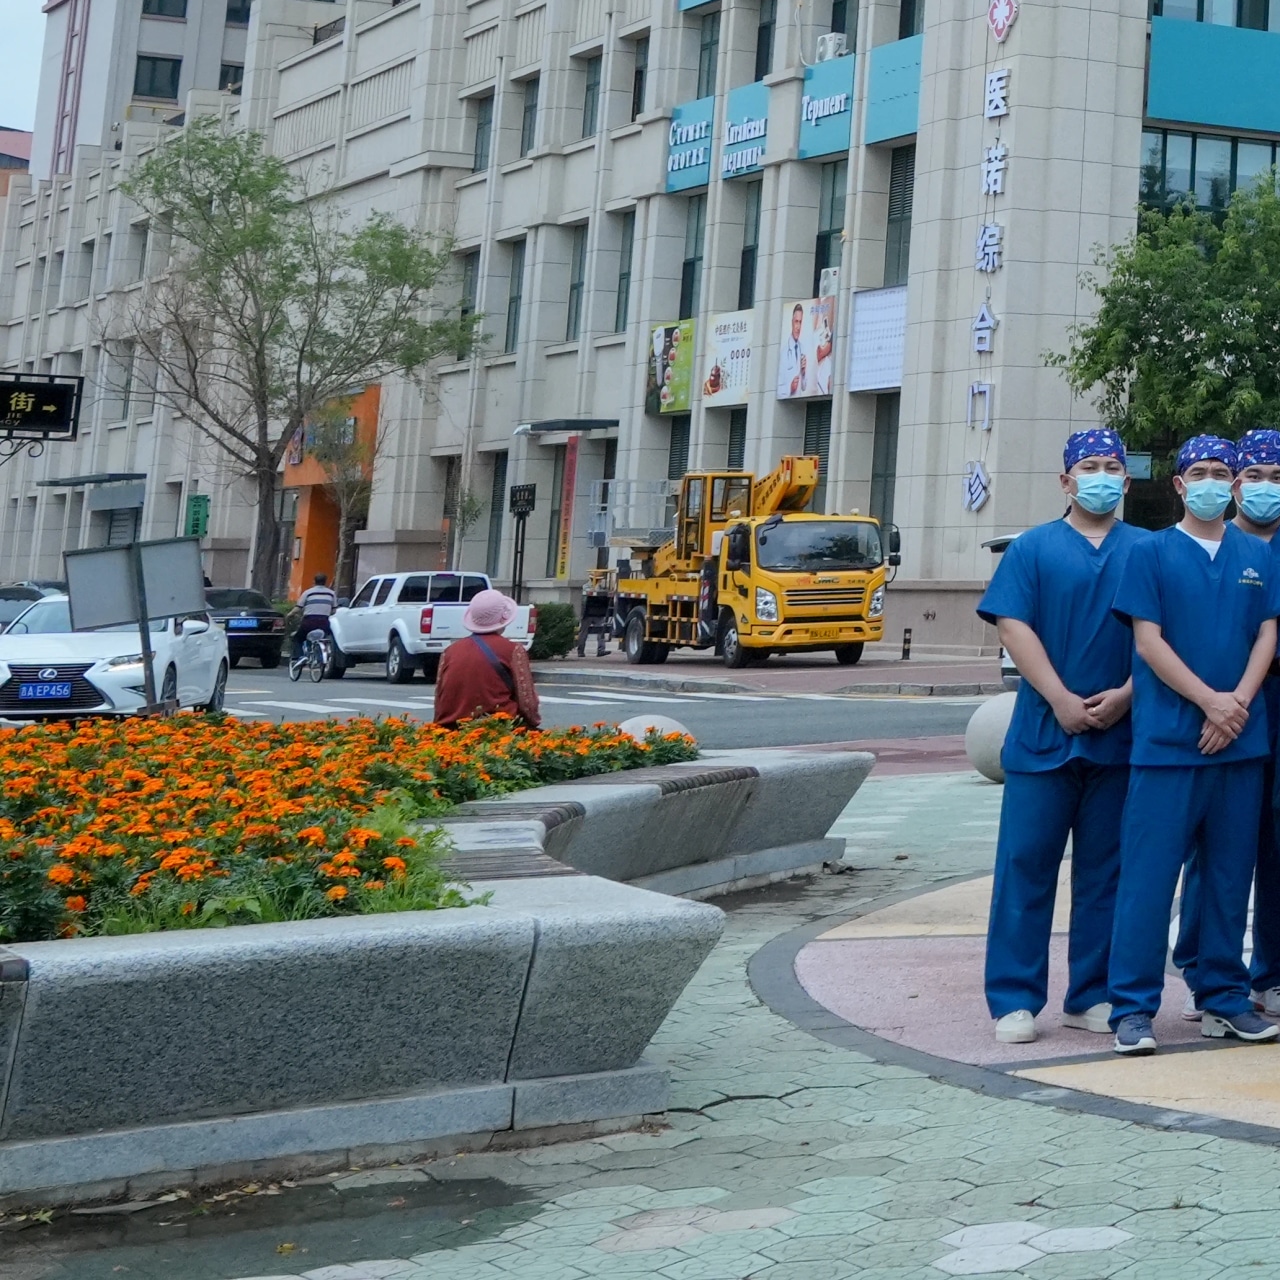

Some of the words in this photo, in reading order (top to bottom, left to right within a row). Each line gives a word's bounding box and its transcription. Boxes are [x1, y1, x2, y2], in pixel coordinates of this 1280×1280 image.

[10, 392, 35, 412] 街
[963, 67, 1011, 512] 医诺综合门诊
